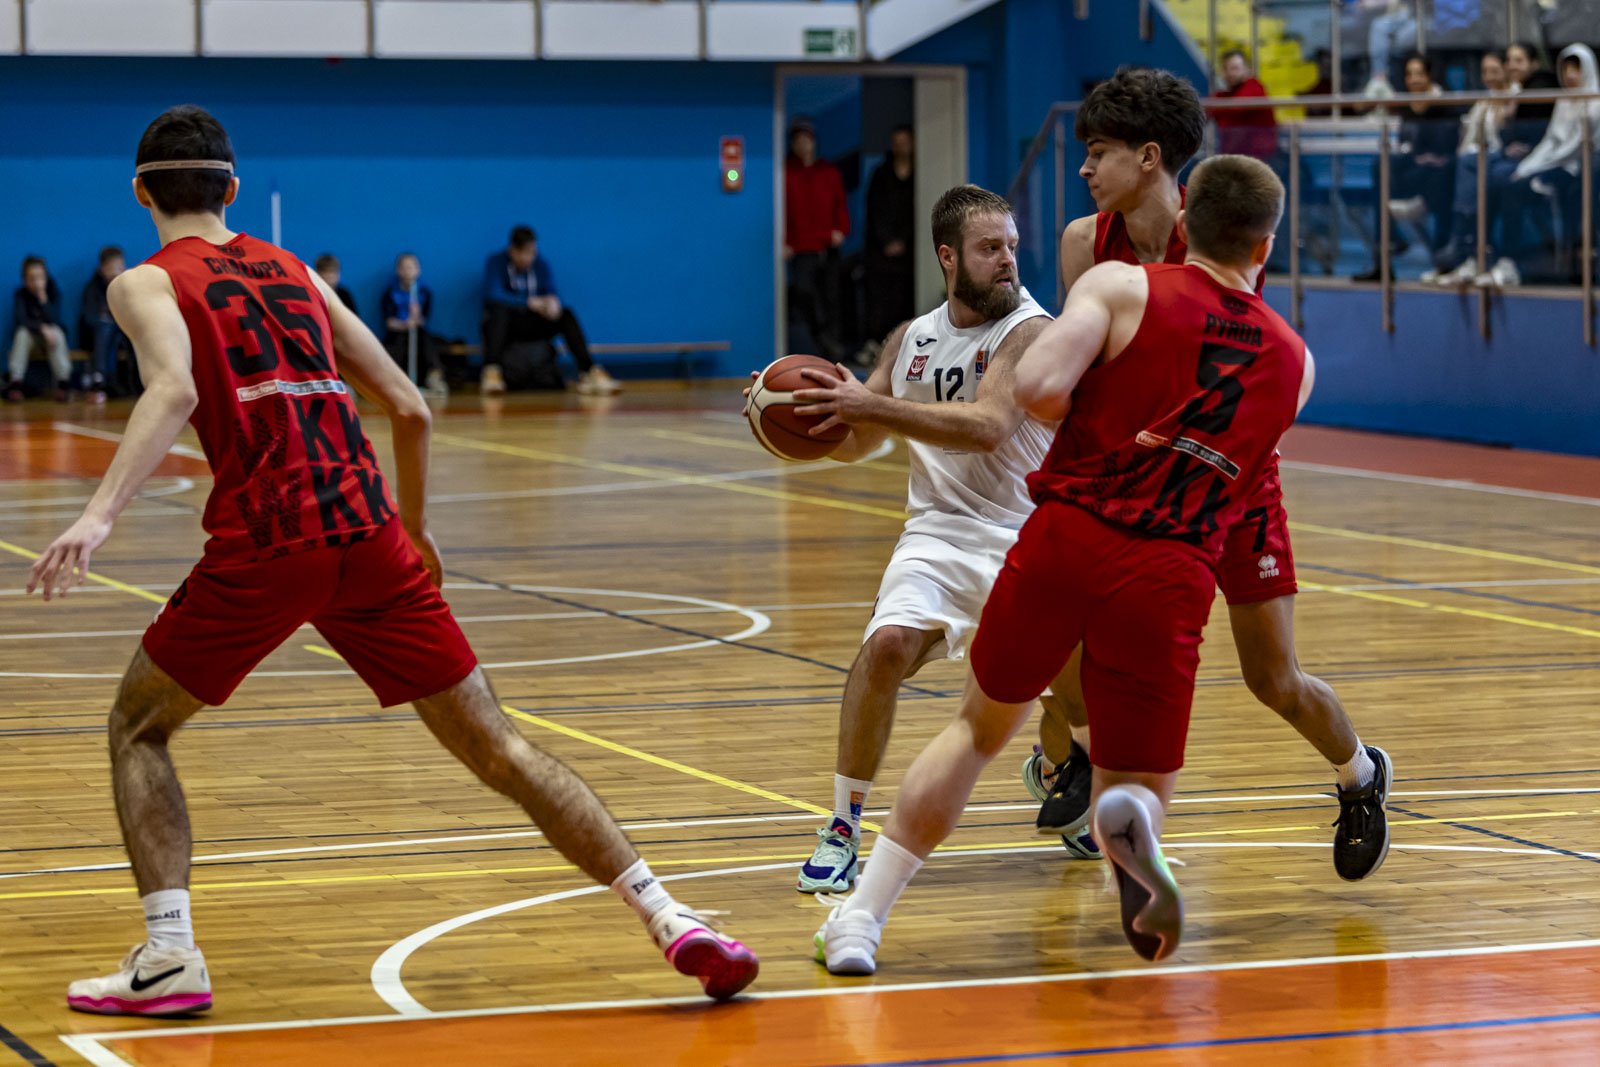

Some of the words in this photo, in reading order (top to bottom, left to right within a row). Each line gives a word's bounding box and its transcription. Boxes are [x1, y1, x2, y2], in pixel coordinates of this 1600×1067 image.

[205, 279, 333, 378] 35
[933, 366, 964, 402] 12
[1244, 505, 1269, 553] 7
